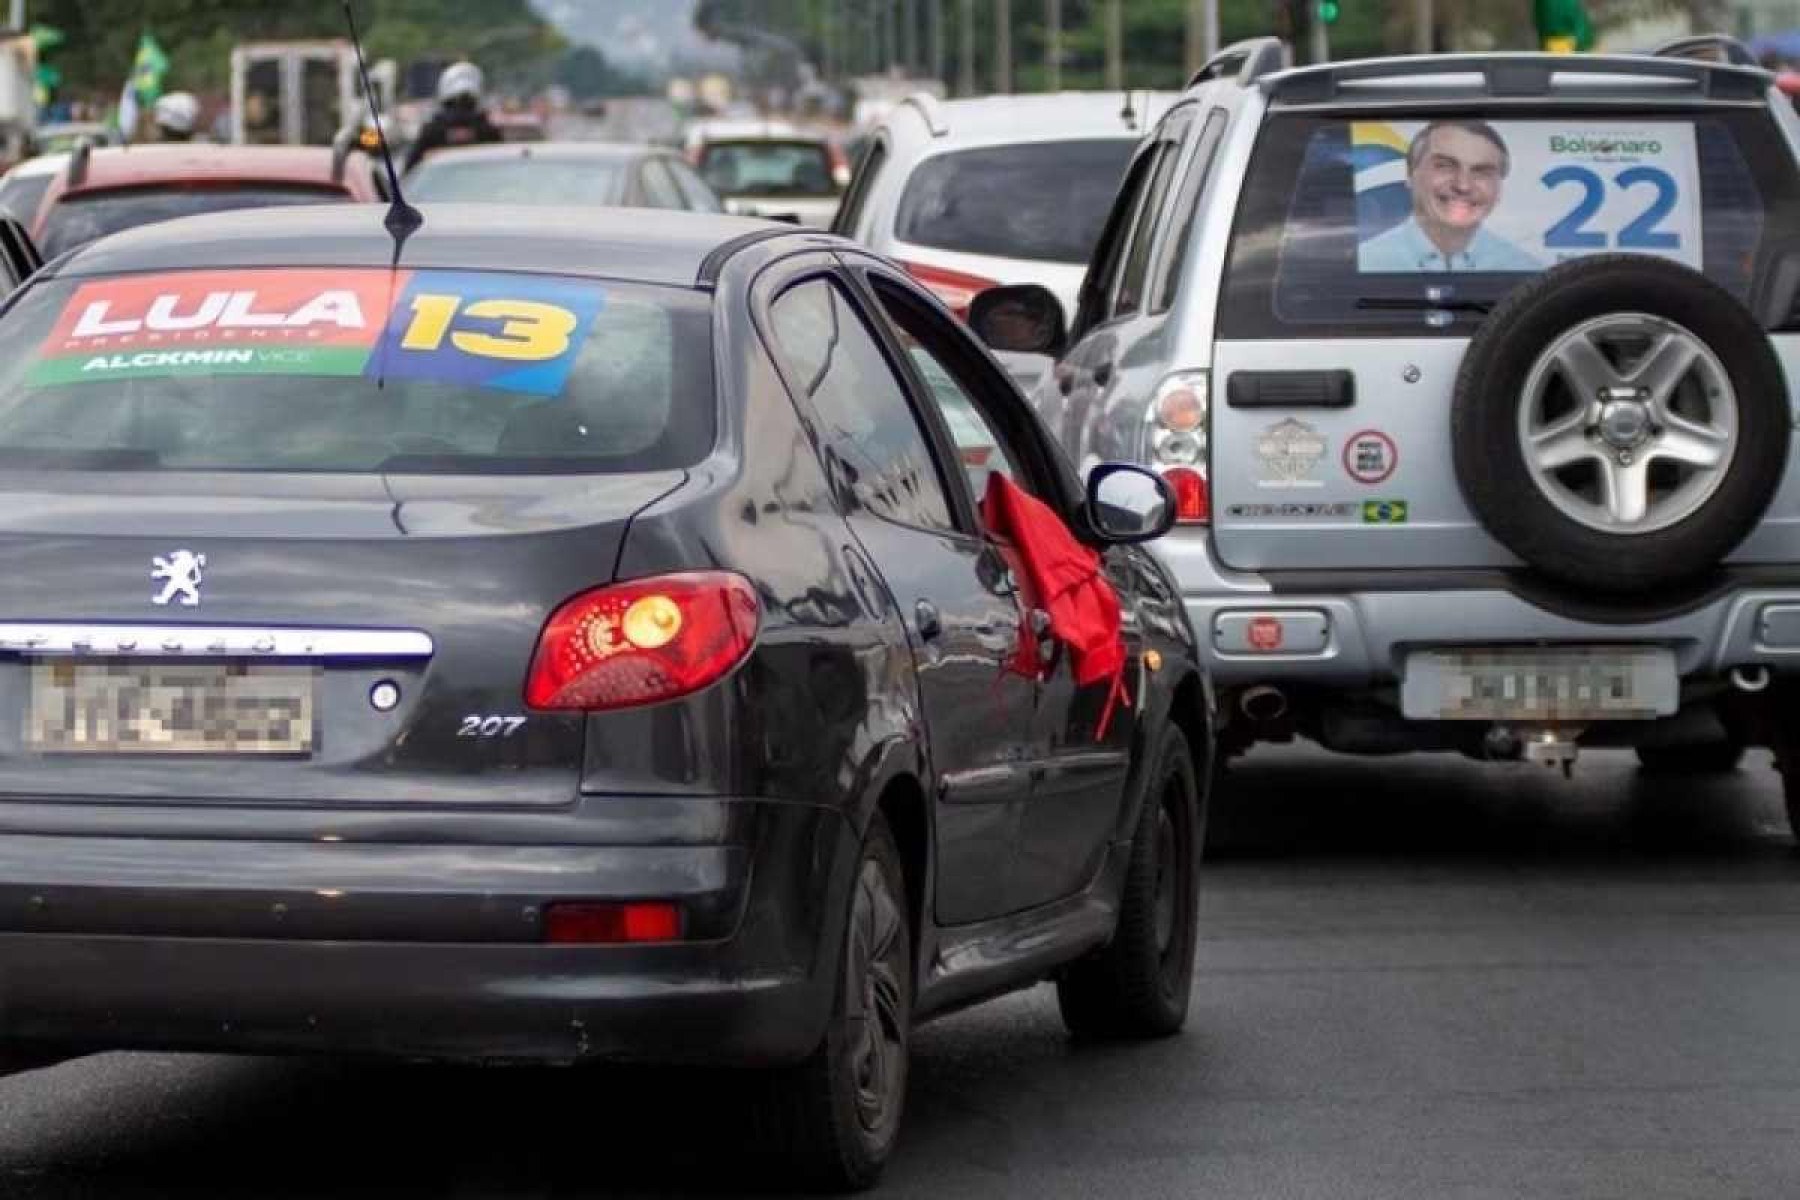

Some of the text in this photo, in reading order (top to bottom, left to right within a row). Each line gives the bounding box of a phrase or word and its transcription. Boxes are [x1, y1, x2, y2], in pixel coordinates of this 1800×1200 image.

[1549, 135, 1662, 153] Bolsonaro
[1541, 165, 1681, 248] 22
[71, 290, 363, 337] LULA
[402, 293, 577, 361] 13
[82, 350, 252, 371] ALCKMIN
[456, 714, 527, 736] 207
